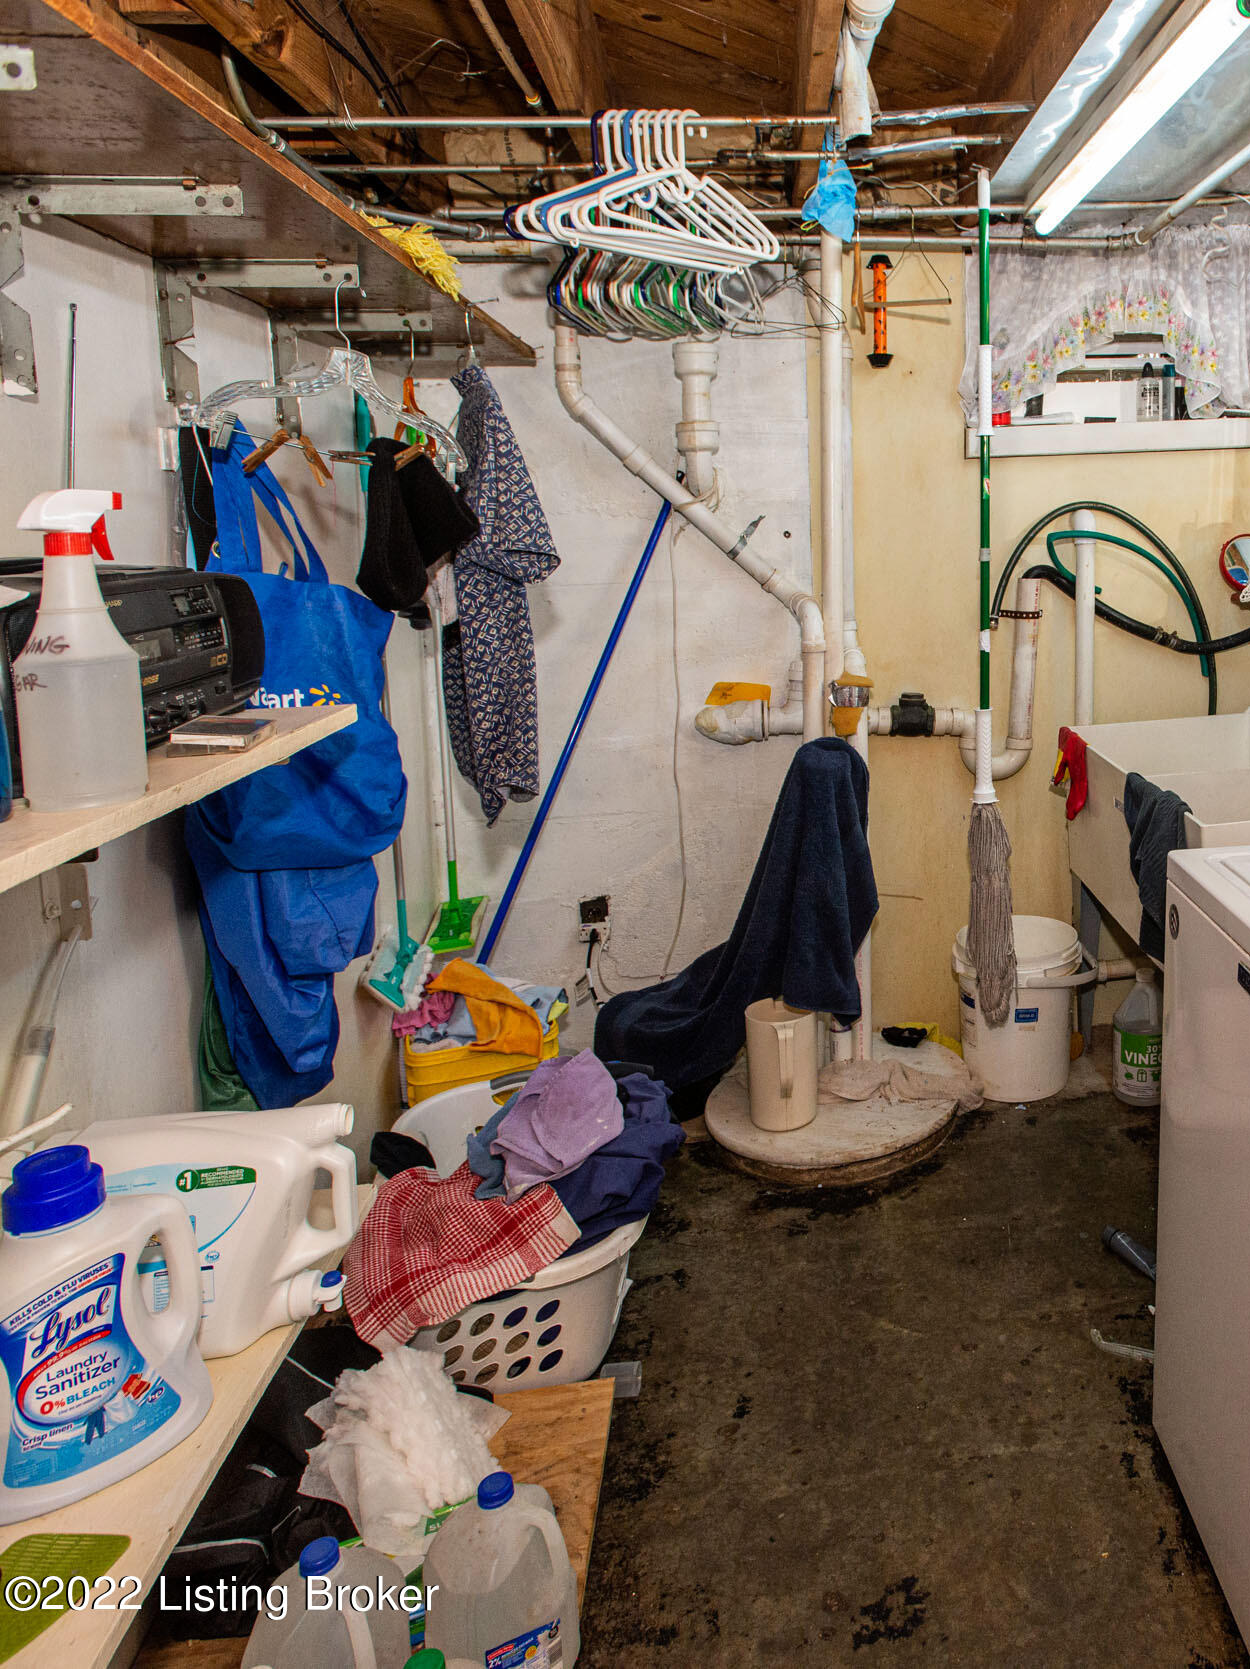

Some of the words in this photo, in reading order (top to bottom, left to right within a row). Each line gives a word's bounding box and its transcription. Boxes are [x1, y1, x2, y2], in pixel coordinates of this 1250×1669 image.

[1146, 1045, 1161, 1054] 30
[178, 1171, 193, 1190] #1
[9, 1307, 32, 1326] KILLS
[32, 1294, 54, 1311] COLD
[61, 1280, 78, 1292] FLU
[77, 1262, 109, 1283] VIRUSES
[29, 1287, 111, 1359] Lysol
[35, 1356, 121, 1400] Sanitizer
[46, 1351, 108, 1382] Laundry
[40, 1399, 66, 1415] 0%
[66, 1377, 116, 1405] BLEACH
[21, 1433, 48, 1447] Crisp
[49, 1423, 73, 1438] linen
